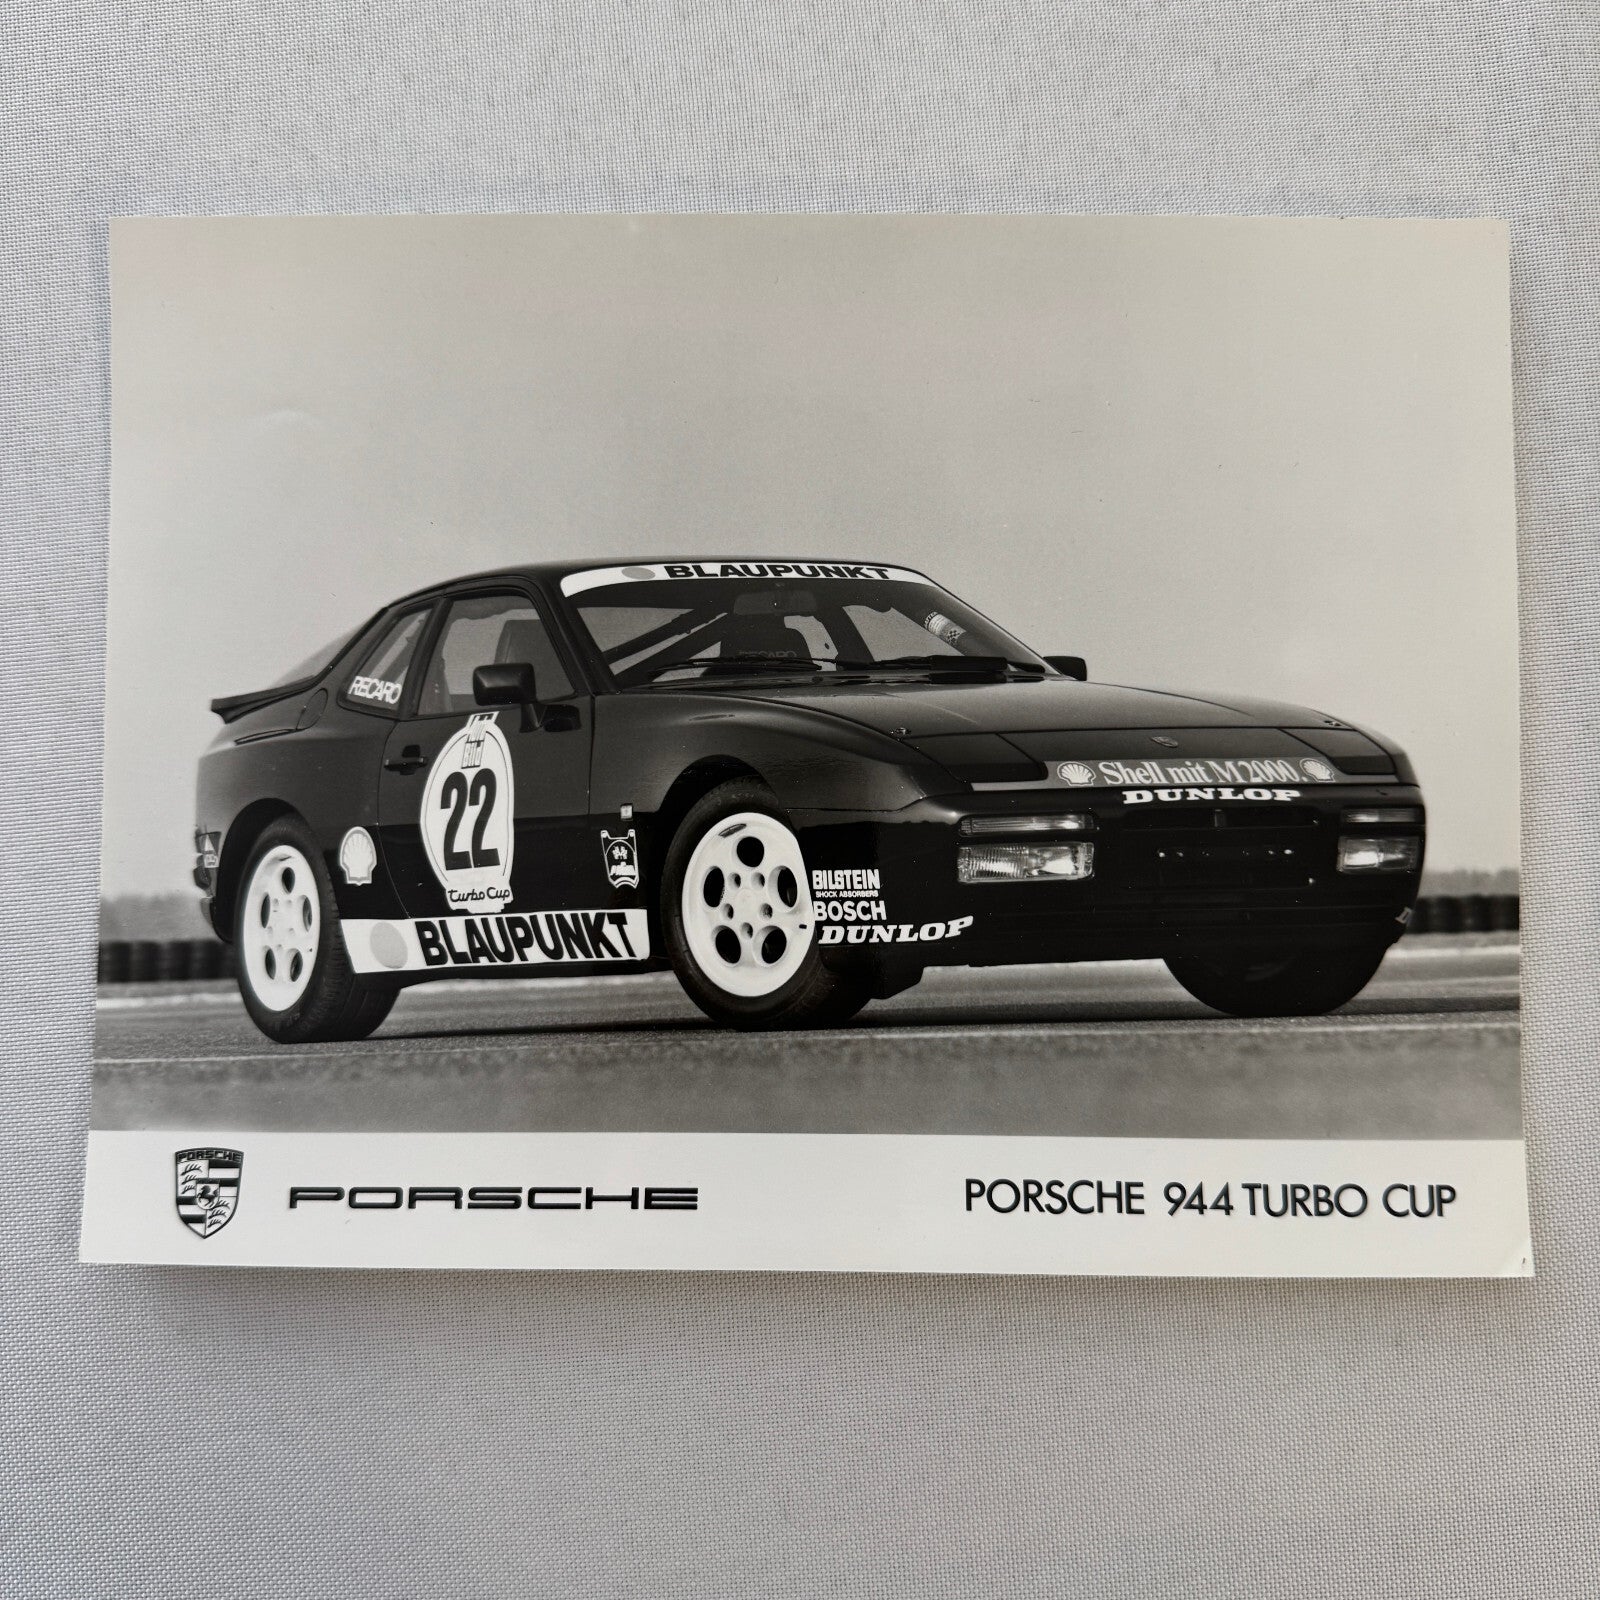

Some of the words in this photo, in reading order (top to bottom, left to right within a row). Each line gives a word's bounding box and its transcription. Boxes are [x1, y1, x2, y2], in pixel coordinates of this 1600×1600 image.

[665, 565, 889, 580] BLAUPUNKT
[348, 675, 402, 705] RECARO
[1098, 761, 1170, 785] Shell
[1166, 761, 1214, 784] mit
[1122, 788, 1301, 804] DUNLOP
[440, 768, 500, 871] 22
[812, 869, 881, 890] BILSTEIN
[486, 886, 511, 901] Cup
[839, 890, 879, 898] ABSORBERS
[813, 900, 887, 922] BOSCH
[414, 911, 638, 967] BLAUPUNKT
[818, 915, 974, 944] DUNLOP
[177, 1149, 242, 1163] PORSCHE
[289, 1186, 699, 1210] PORSCHE
[965, 1178, 1146, 1216] PORSCHE
[1163, 1181, 1235, 1217] 944
[1241, 1182, 1369, 1219] TURBO
[1381, 1183, 1457, 1219] CUP
